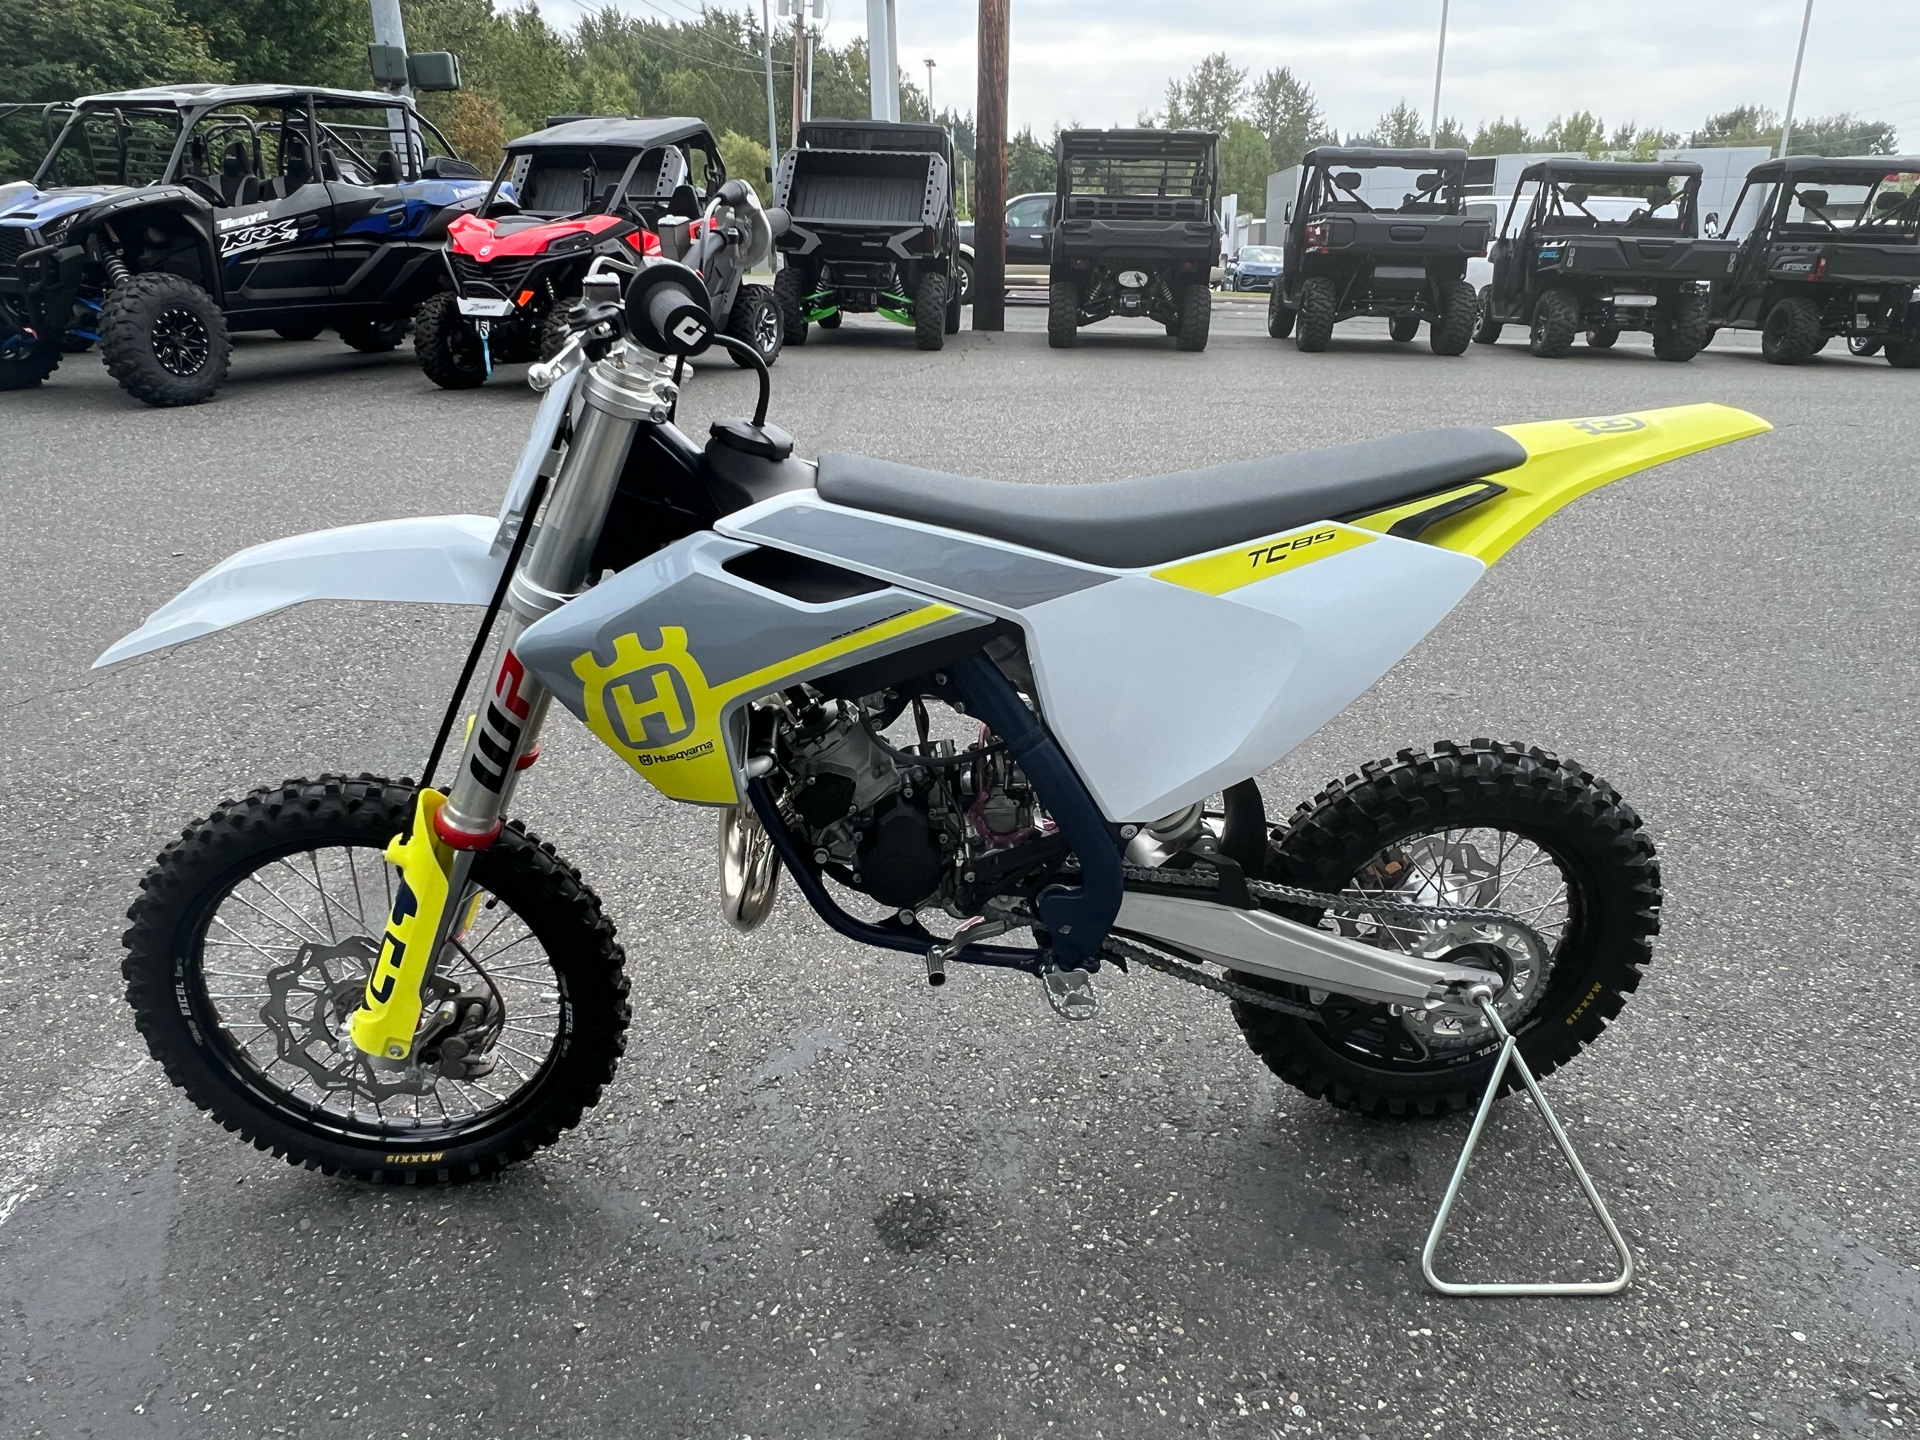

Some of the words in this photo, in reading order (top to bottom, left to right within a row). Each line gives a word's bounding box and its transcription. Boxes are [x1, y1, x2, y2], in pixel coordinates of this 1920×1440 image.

[1248, 529, 1337, 568] TC85
[653, 741, 713, 763] Husqvarna
[1566, 981, 1602, 1026] MAXXIS
[385, 1152, 443, 1164] MAXXIS
